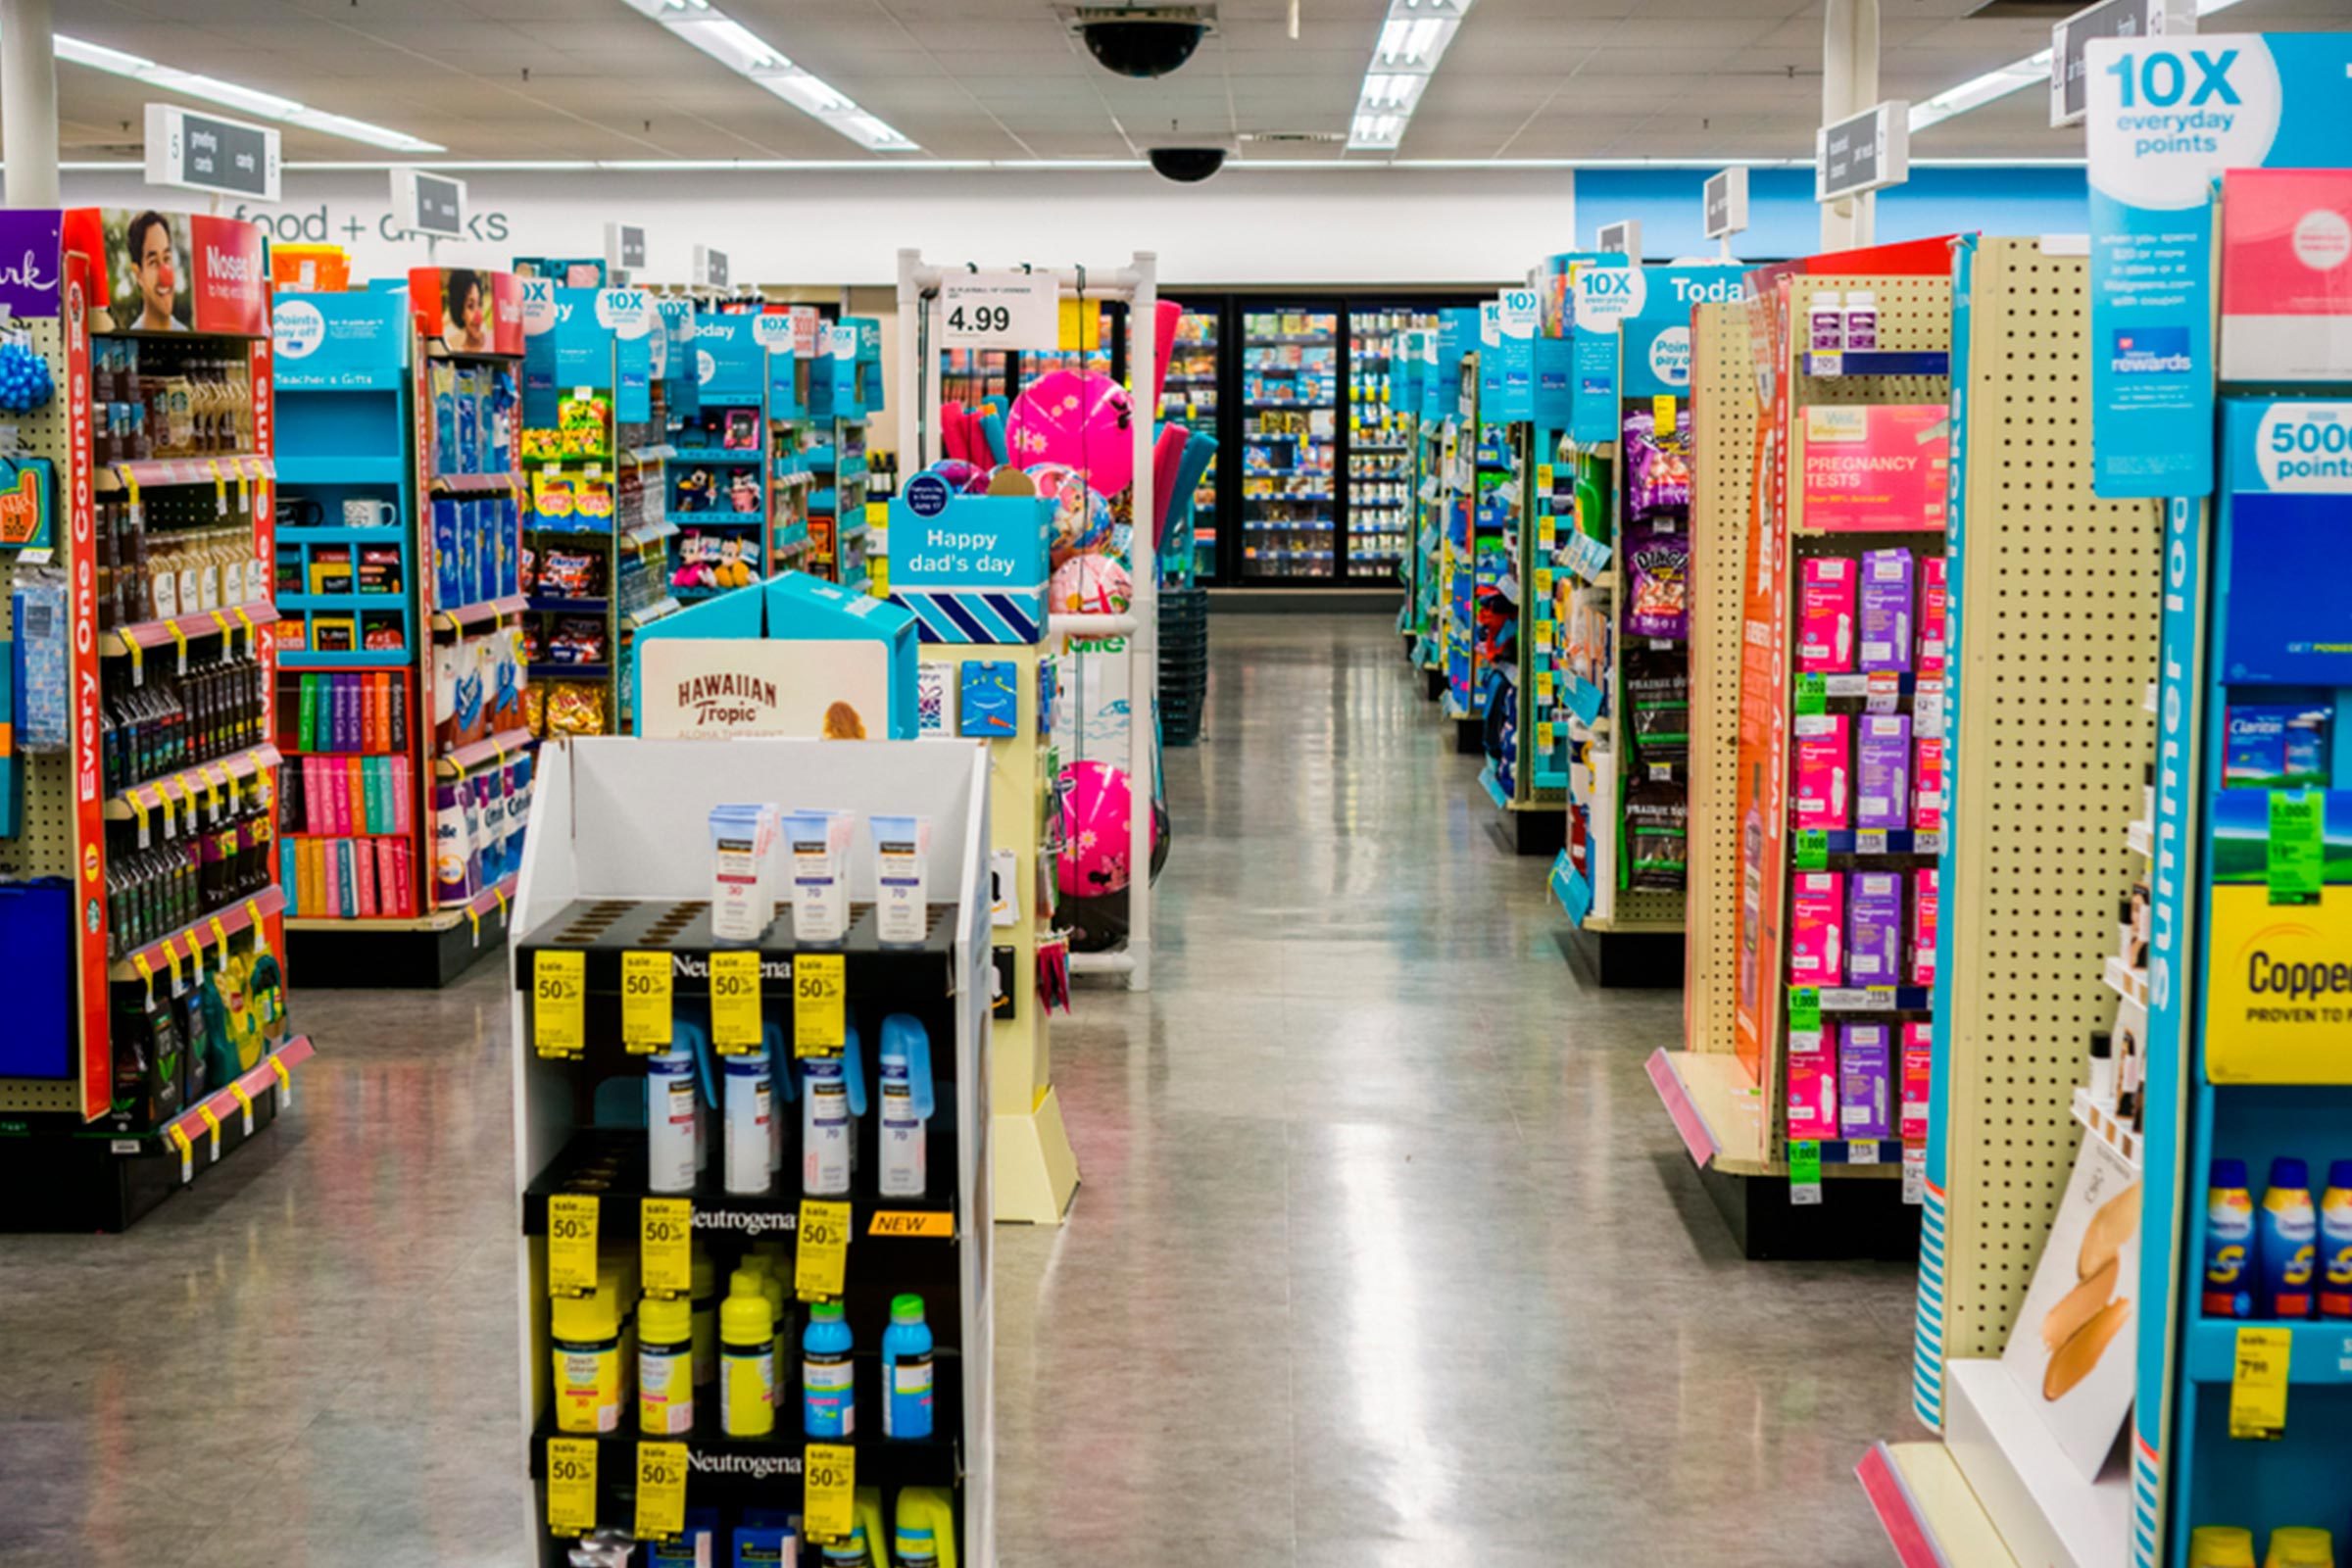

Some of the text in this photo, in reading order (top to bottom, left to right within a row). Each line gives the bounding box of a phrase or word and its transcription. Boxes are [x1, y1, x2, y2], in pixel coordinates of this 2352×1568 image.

[2106, 50, 2241, 108] 10X
[2116, 110, 2235, 132] everyday
[2134, 135, 2219, 158] points
[0, 250, 59, 291] rk
[206, 245, 250, 280] Noses
[1583, 273, 1631, 295] 10X
[1670, 276, 1743, 302] Toda
[606, 292, 643, 310] 10X
[657, 302, 690, 318] 10X
[760, 318, 790, 331] 10X
[948, 305, 1011, 332] 4.99
[694, 323, 735, 340] oday
[1655, 340, 1690, 353] Poin
[2111, 354, 2193, 372] rewards
[2271, 422, 2352, 454] 500
[72, 373, 88, 543] Counts
[1807, 457, 1918, 471] PREGNANCY
[2277, 455, 2352, 481] point
[1773, 397, 1786, 572] Counts
[1805, 473, 1861, 488] TESTS
[926, 529, 998, 551] Happy
[908, 554, 1015, 576] dad's day
[2166, 496, 2187, 612] loo
[76, 560, 91, 655] One
[1771, 591, 1785, 687] One
[678, 672, 776, 709] HAWAIIAN
[694, 701, 757, 725] Tropic
[80, 671, 97, 803] Every
[1768, 703, 1784, 840] Every
[807, 888, 821, 899] 70
[892, 889, 907, 899] 70
[672, 953, 792, 979] Neuena
[2249, 950, 2352, 1002] Coppe
[1791, 995, 1819, 1006] 1,000
[2246, 1008, 2343, 1022] PROVEN TO
[876, 1216, 927, 1232] NEW
[687, 1450, 803, 1479] Neutrogena
